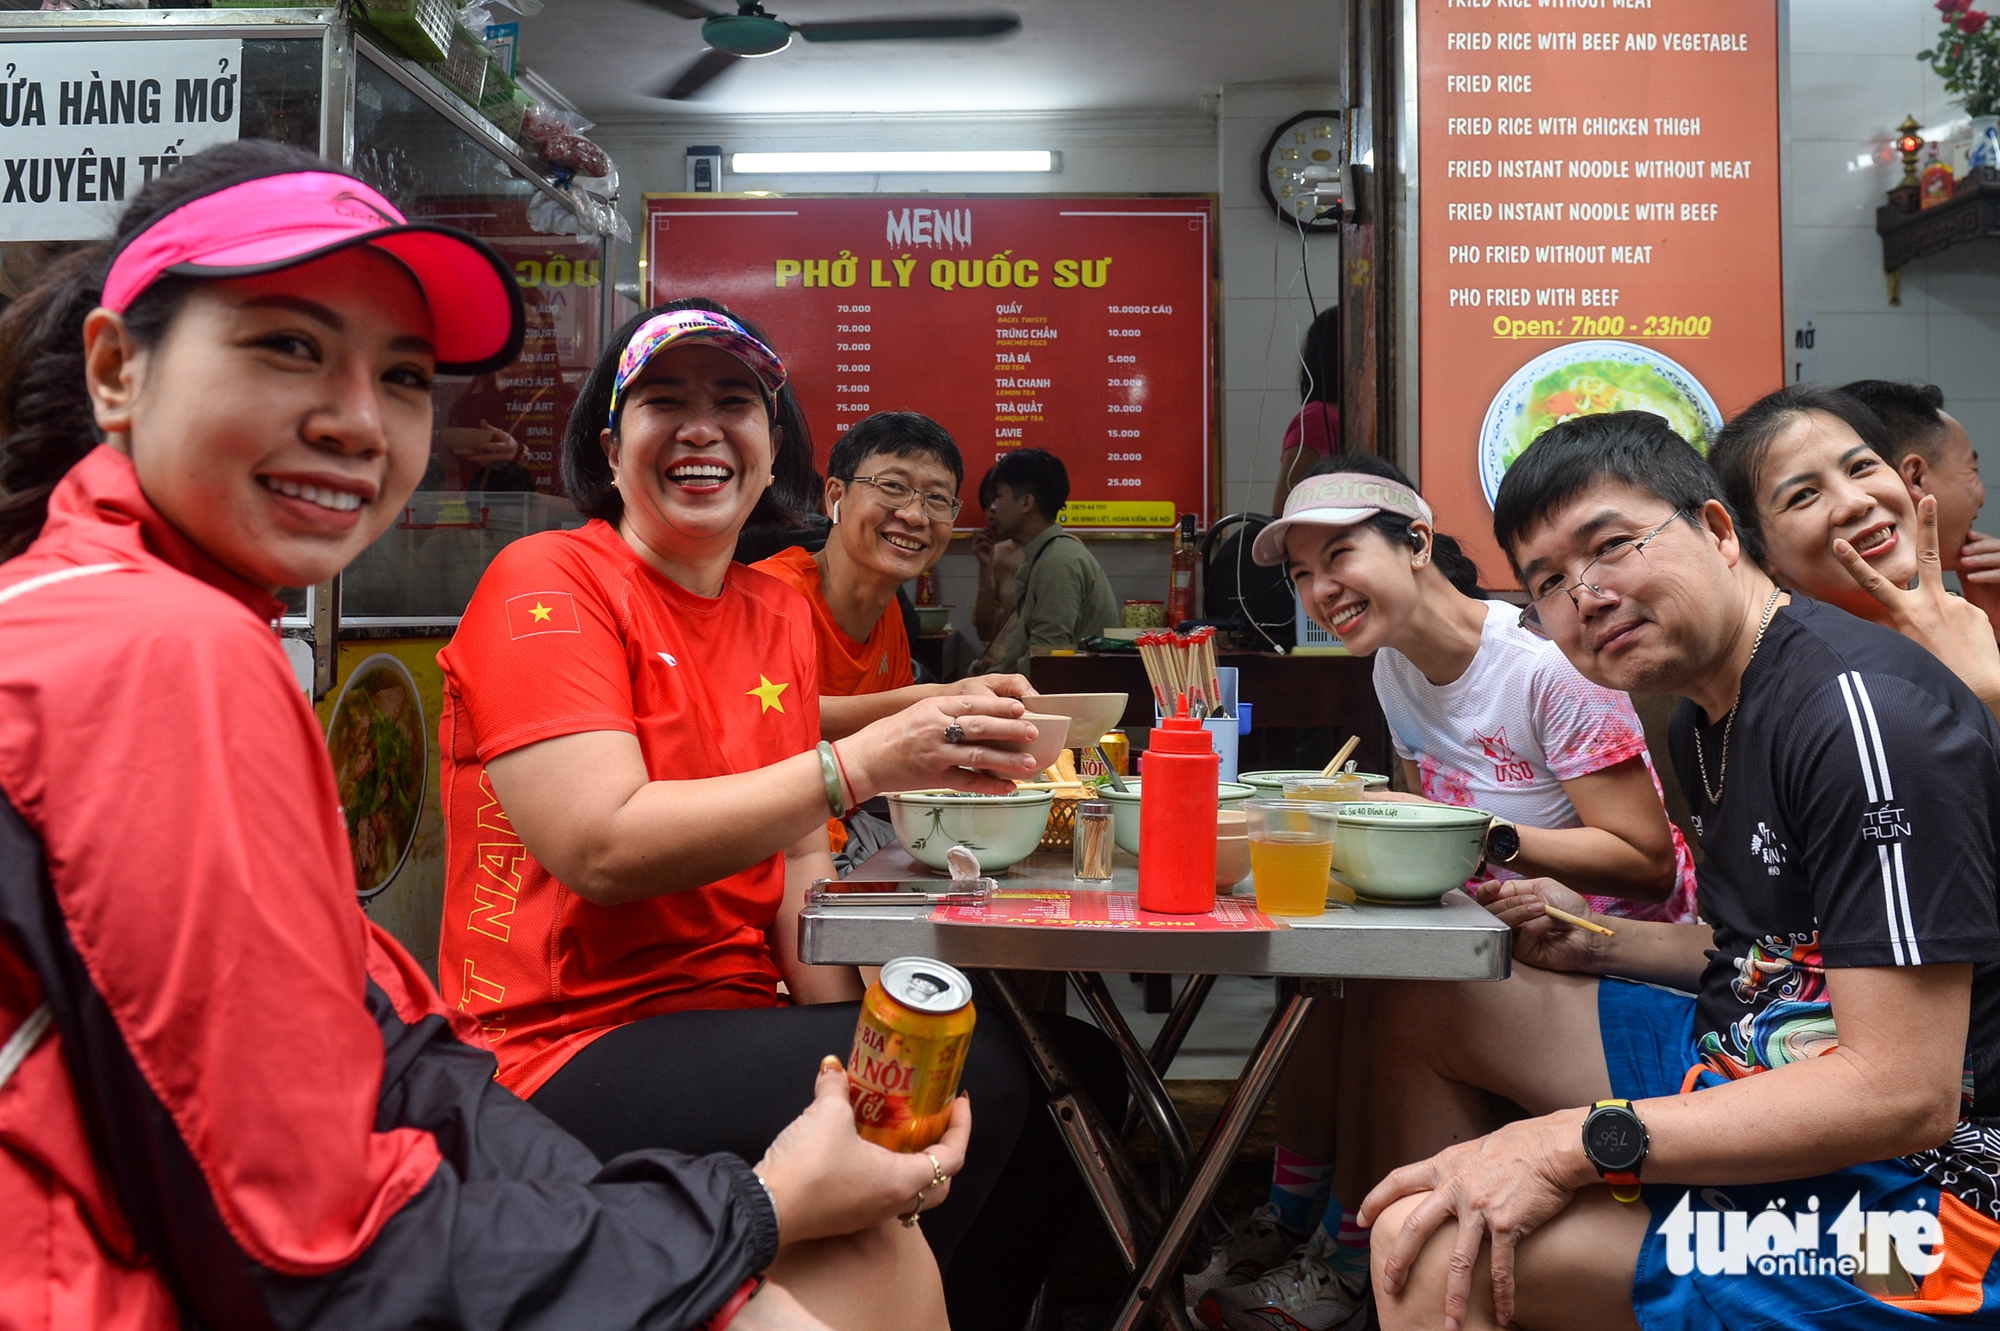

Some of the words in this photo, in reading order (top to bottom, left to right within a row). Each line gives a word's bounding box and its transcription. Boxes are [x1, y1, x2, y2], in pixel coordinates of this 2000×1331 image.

[1447, 33, 1491, 50] FRIED
[1497, 33, 1532, 50] RICE
[1538, 32, 1576, 50] WITH
[1582, 33, 1620, 50] BEEF
[1625, 33, 1657, 51] AND
[1663, 33, 1748, 51] VEGETABLE
[0, 63, 46, 127] ỬA
[59, 71, 161, 125] HÀNG
[175, 58, 238, 123] MỞ
[1447, 75, 1492, 93] FRIED
[1497, 75, 1532, 93] RICE
[1448, 118, 1492, 135] FRIED
[1498, 118, 1532, 135] RICE
[1538, 117, 1577, 135] WITH
[1582, 117, 1649, 136] CHICKEN
[1654, 117, 1701, 136] THIGH
[4, 147, 125, 203] XUYÊN
[1448, 160, 1492, 178] FRIED
[1498, 160, 1563, 178] INSTANT
[1568, 160, 1629, 178] NOODLE
[1635, 160, 1705, 178] WITHOUT
[1710, 161, 1751, 179] MEAT
[1448, 203, 1493, 221] FRIED
[1499, 203, 1563, 221] INSTANT
[1569, 203, 1630, 221] NOODLE
[1635, 203, 1675, 221] WITH
[1680, 204, 1719, 221] BEEF
[886, 208, 972, 250] MENU
[1449, 245, 1480, 264] PHO
[1486, 246, 1531, 264] FRIED
[1535, 245, 1606, 264] WITHOUT
[1611, 246, 1652, 264] MEAT
[775, 250, 859, 288] PHỞ
[870, 254, 917, 287] LÝ
[930, 250, 1040, 291] QUỐC
[1052, 257, 1113, 288] SƯ
[1449, 288, 1481, 306] PHO
[1486, 289, 1531, 306] FRIED
[1536, 288, 1575, 306] WITH
[1581, 289, 1620, 306] BEEF
[837, 305, 871, 313] 70.000
[1108, 305, 1151, 315] 10.000(2
[1108, 329, 1141, 337] 10.000
[1493, 316, 1563, 339] Open:
[1569, 316, 1626, 336] 7h00
[1643, 316, 1712, 336] 23h00
[996, 352, 1016, 363] TRÀ
[1017, 352, 1032, 363] ĐÁ
[1108, 355, 1136, 363] 5.000
[995, 377, 1016, 388] TRÀ
[1017, 378, 1051, 388] CHANH
[1108, 379, 1142, 387] 20.000
[995, 401, 1016, 413] TRÀ
[1108, 405, 1142, 413] 20.000
[995, 428, 1022, 438] LAVIE
[1108, 430, 1140, 438] 15.000
[1108, 453, 1142, 461] 20.000
[1108, 478, 1141, 486] 25.000
[1864, 804, 1905, 825] TẾT
[1862, 822, 1912, 840] RUN
[862, 1027, 885, 1054] BIA
[862, 1060, 916, 1096] NỘI
